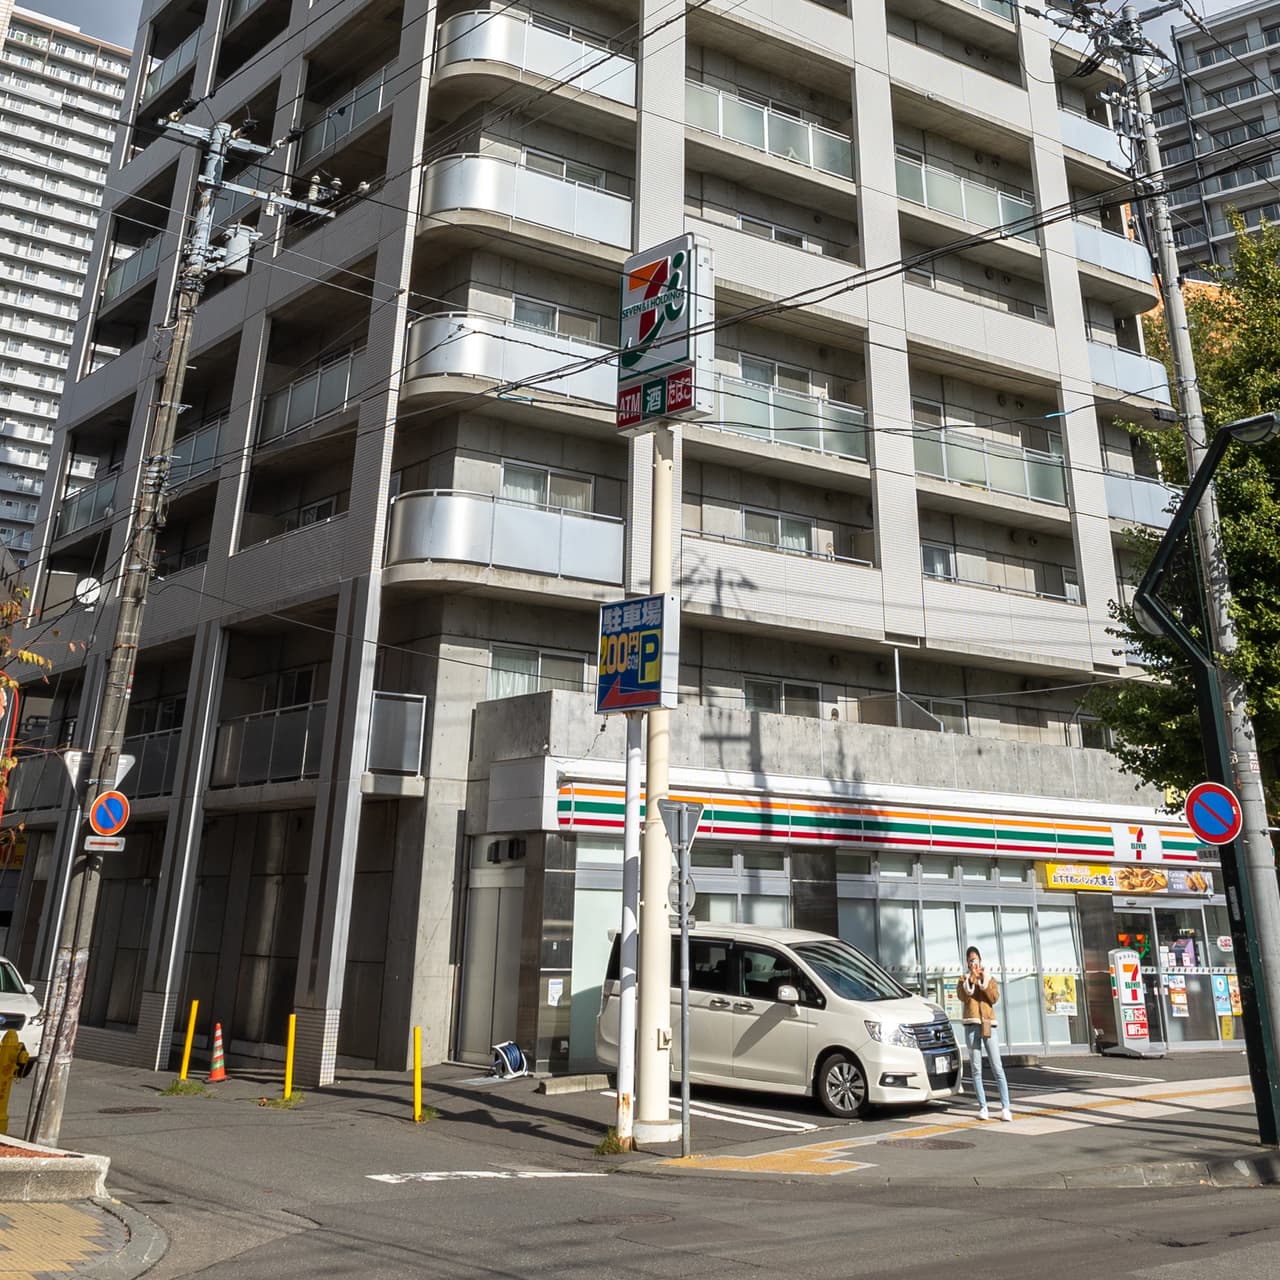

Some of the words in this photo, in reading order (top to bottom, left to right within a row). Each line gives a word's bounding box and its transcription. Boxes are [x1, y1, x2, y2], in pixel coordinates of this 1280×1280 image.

[619, 391, 641, 421] ATM
[646, 385, 662, 414] 酒
[667, 377, 692, 406] たばこ
[602, 600, 662, 635] 駐車場
[639, 632, 660, 681] P
[1128, 826, 1144, 860] 7
[1122, 963, 1139, 1001] 7
